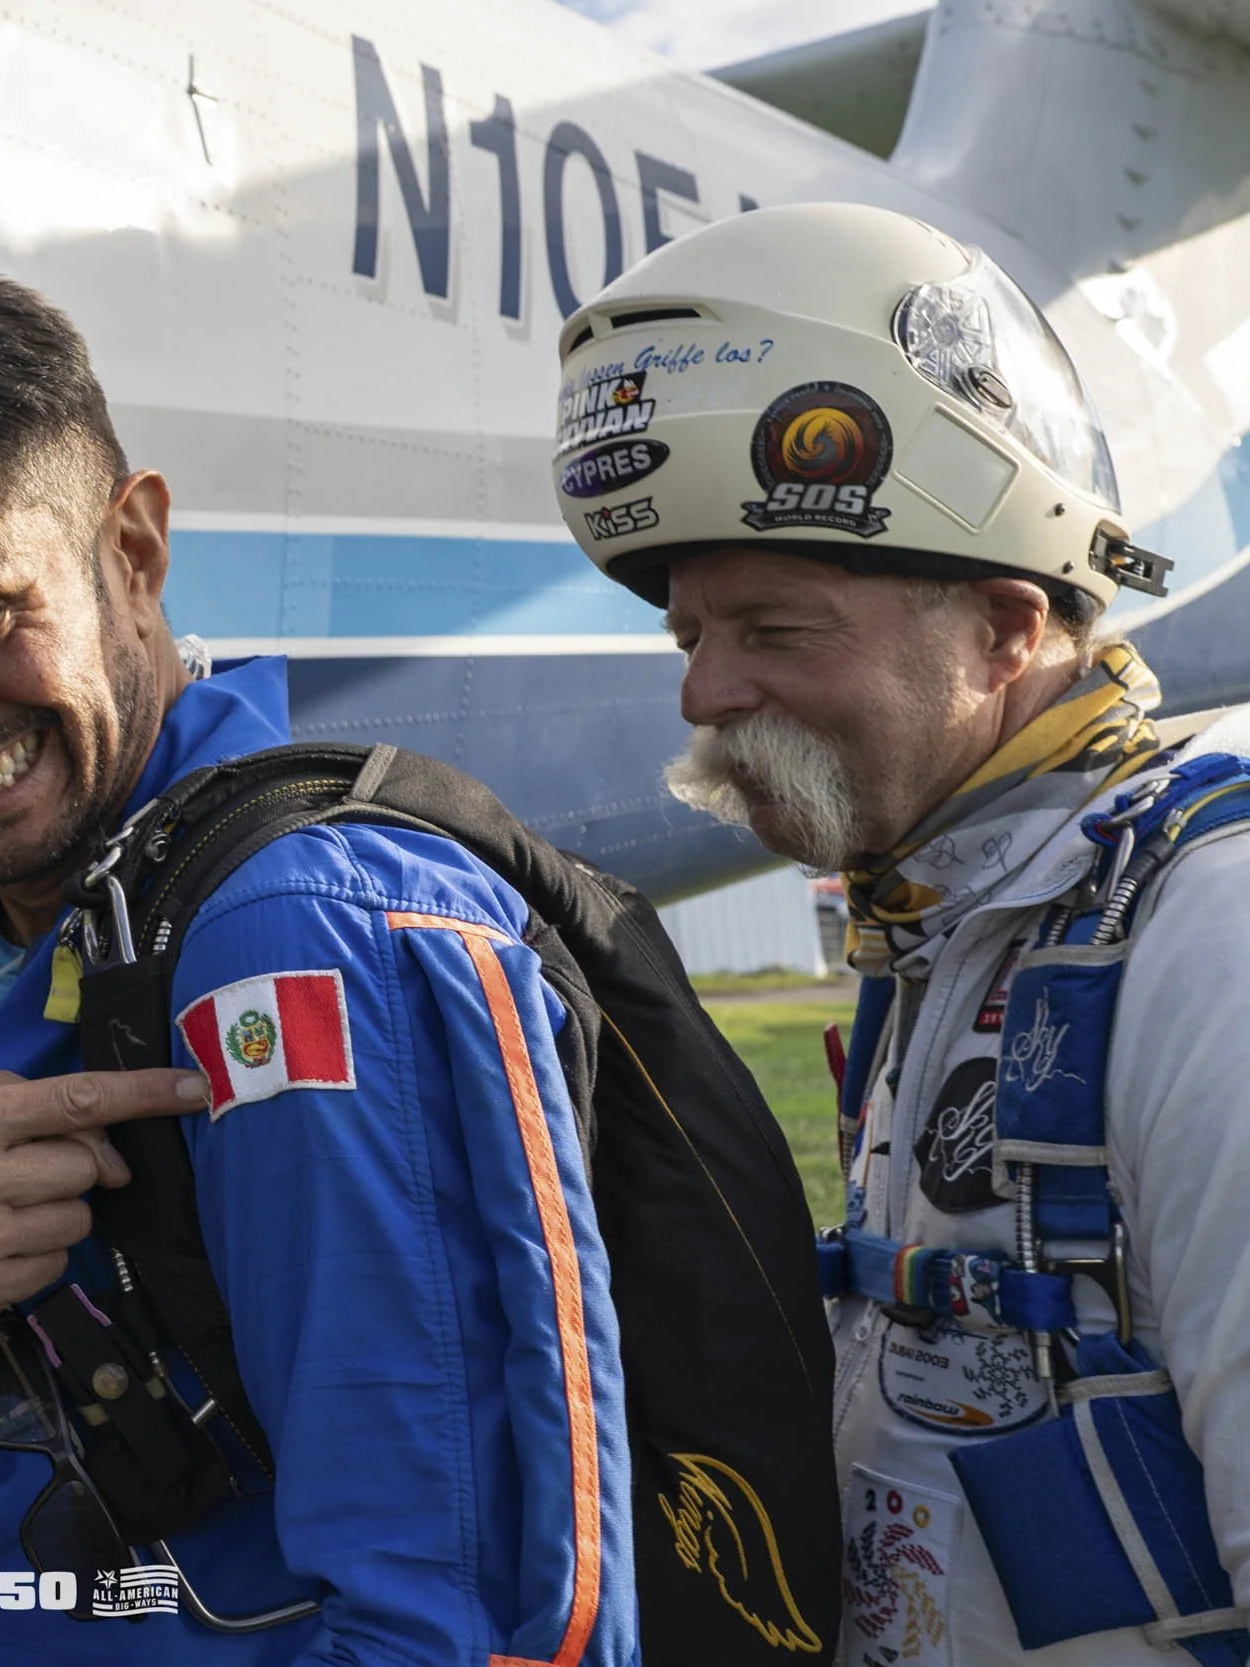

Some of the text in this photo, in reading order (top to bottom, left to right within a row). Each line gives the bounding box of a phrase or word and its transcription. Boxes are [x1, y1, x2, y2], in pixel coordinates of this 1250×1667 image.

[634, 344, 704, 375] Griffe
[715, 339, 775, 363] los?
[560, 445, 652, 493] CYPRES
[766, 483, 867, 515] SOS
[897, 1392, 960, 1416] rainbow
